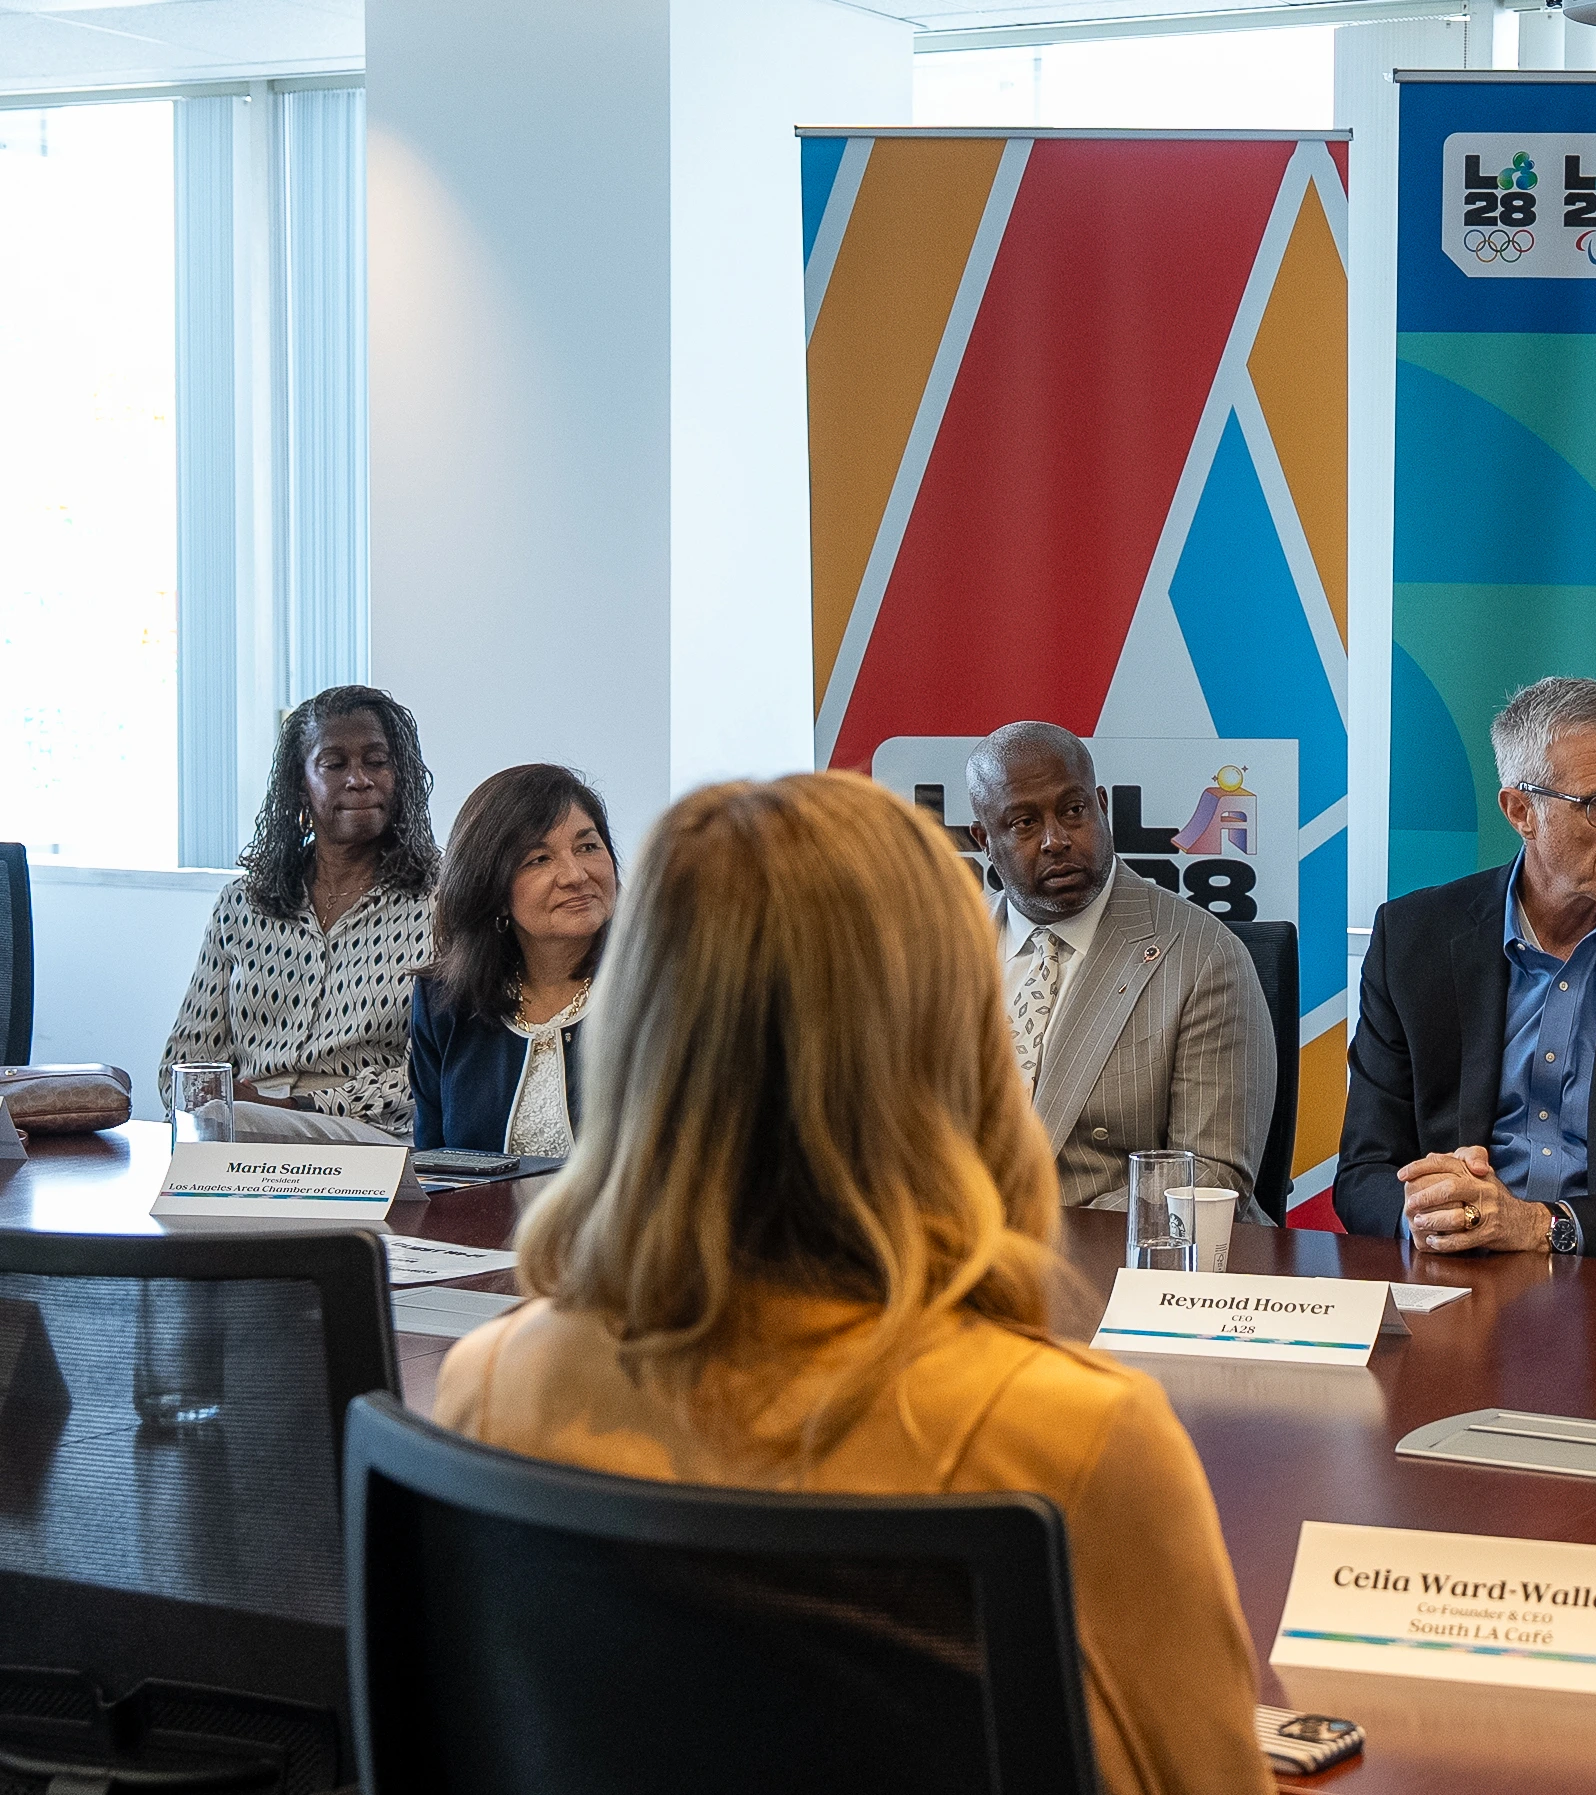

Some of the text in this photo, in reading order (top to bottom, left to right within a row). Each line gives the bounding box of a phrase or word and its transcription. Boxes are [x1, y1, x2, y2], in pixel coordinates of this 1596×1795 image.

[1464, 151, 1538, 190] LA
[1463, 191, 1537, 227] 28
[1111, 765, 1258, 855] LA
[226, 1162, 342, 1176] Maria Salinas
[168, 1183, 188, 1191] Los
[189, 1184, 232, 1192] Angeles
[261, 1186, 312, 1194] Chamber
[328, 1187, 386, 1196] Commerce
[1159, 1292, 1335, 1316] Reynold Hoover
[1220, 1325, 1256, 1335] LA28
[1231, 1314, 1253, 1323] CEO
[1333, 1564, 1410, 1593] Celia
[1417, 1602, 1554, 1625] Co-Founder & CEO
[1408, 1618, 1554, 1645] South LA Café
